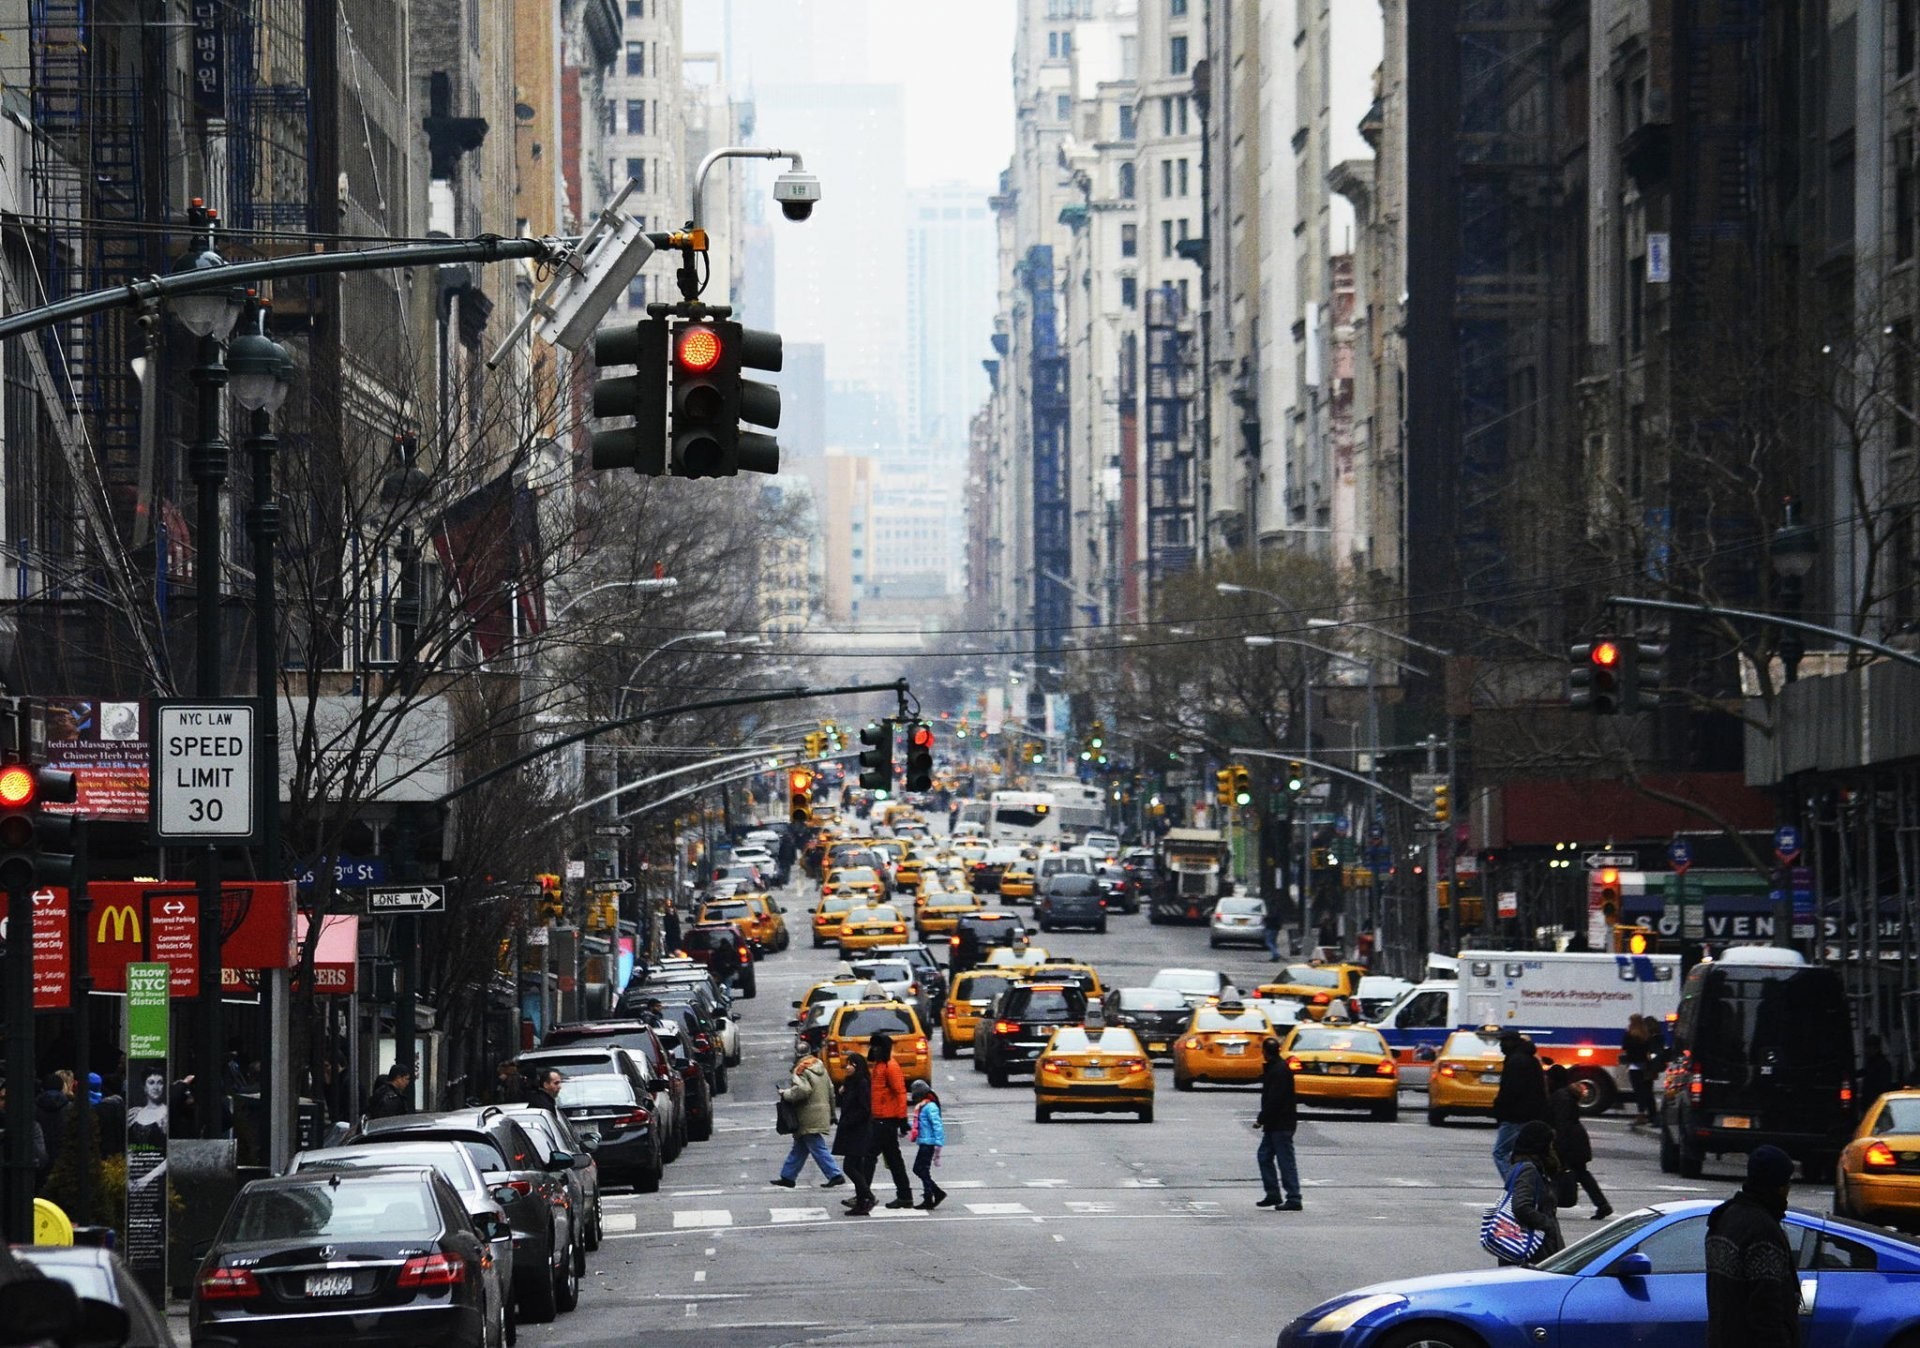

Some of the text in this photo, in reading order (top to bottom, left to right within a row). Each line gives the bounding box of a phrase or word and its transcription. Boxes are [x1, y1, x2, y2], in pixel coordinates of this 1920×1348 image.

[180, 714, 232, 725] NYC LAW
[80, 741, 118, 750] Massage,
[120, 741, 148, 750] Acupu
[170, 737, 243, 756] SPEED
[178, 768, 234, 787] LIMIT
[189, 799, 222, 821] 30
[333, 865, 353, 881] 3rd
[358, 865, 374, 880] St
[379, 894, 433, 905] ONE WAY
[1636, 915, 1838, 937] SOVENS
[131, 968, 165, 977] know
[131, 979, 165, 990] NYC
[131, 1049, 165, 1057] Building
